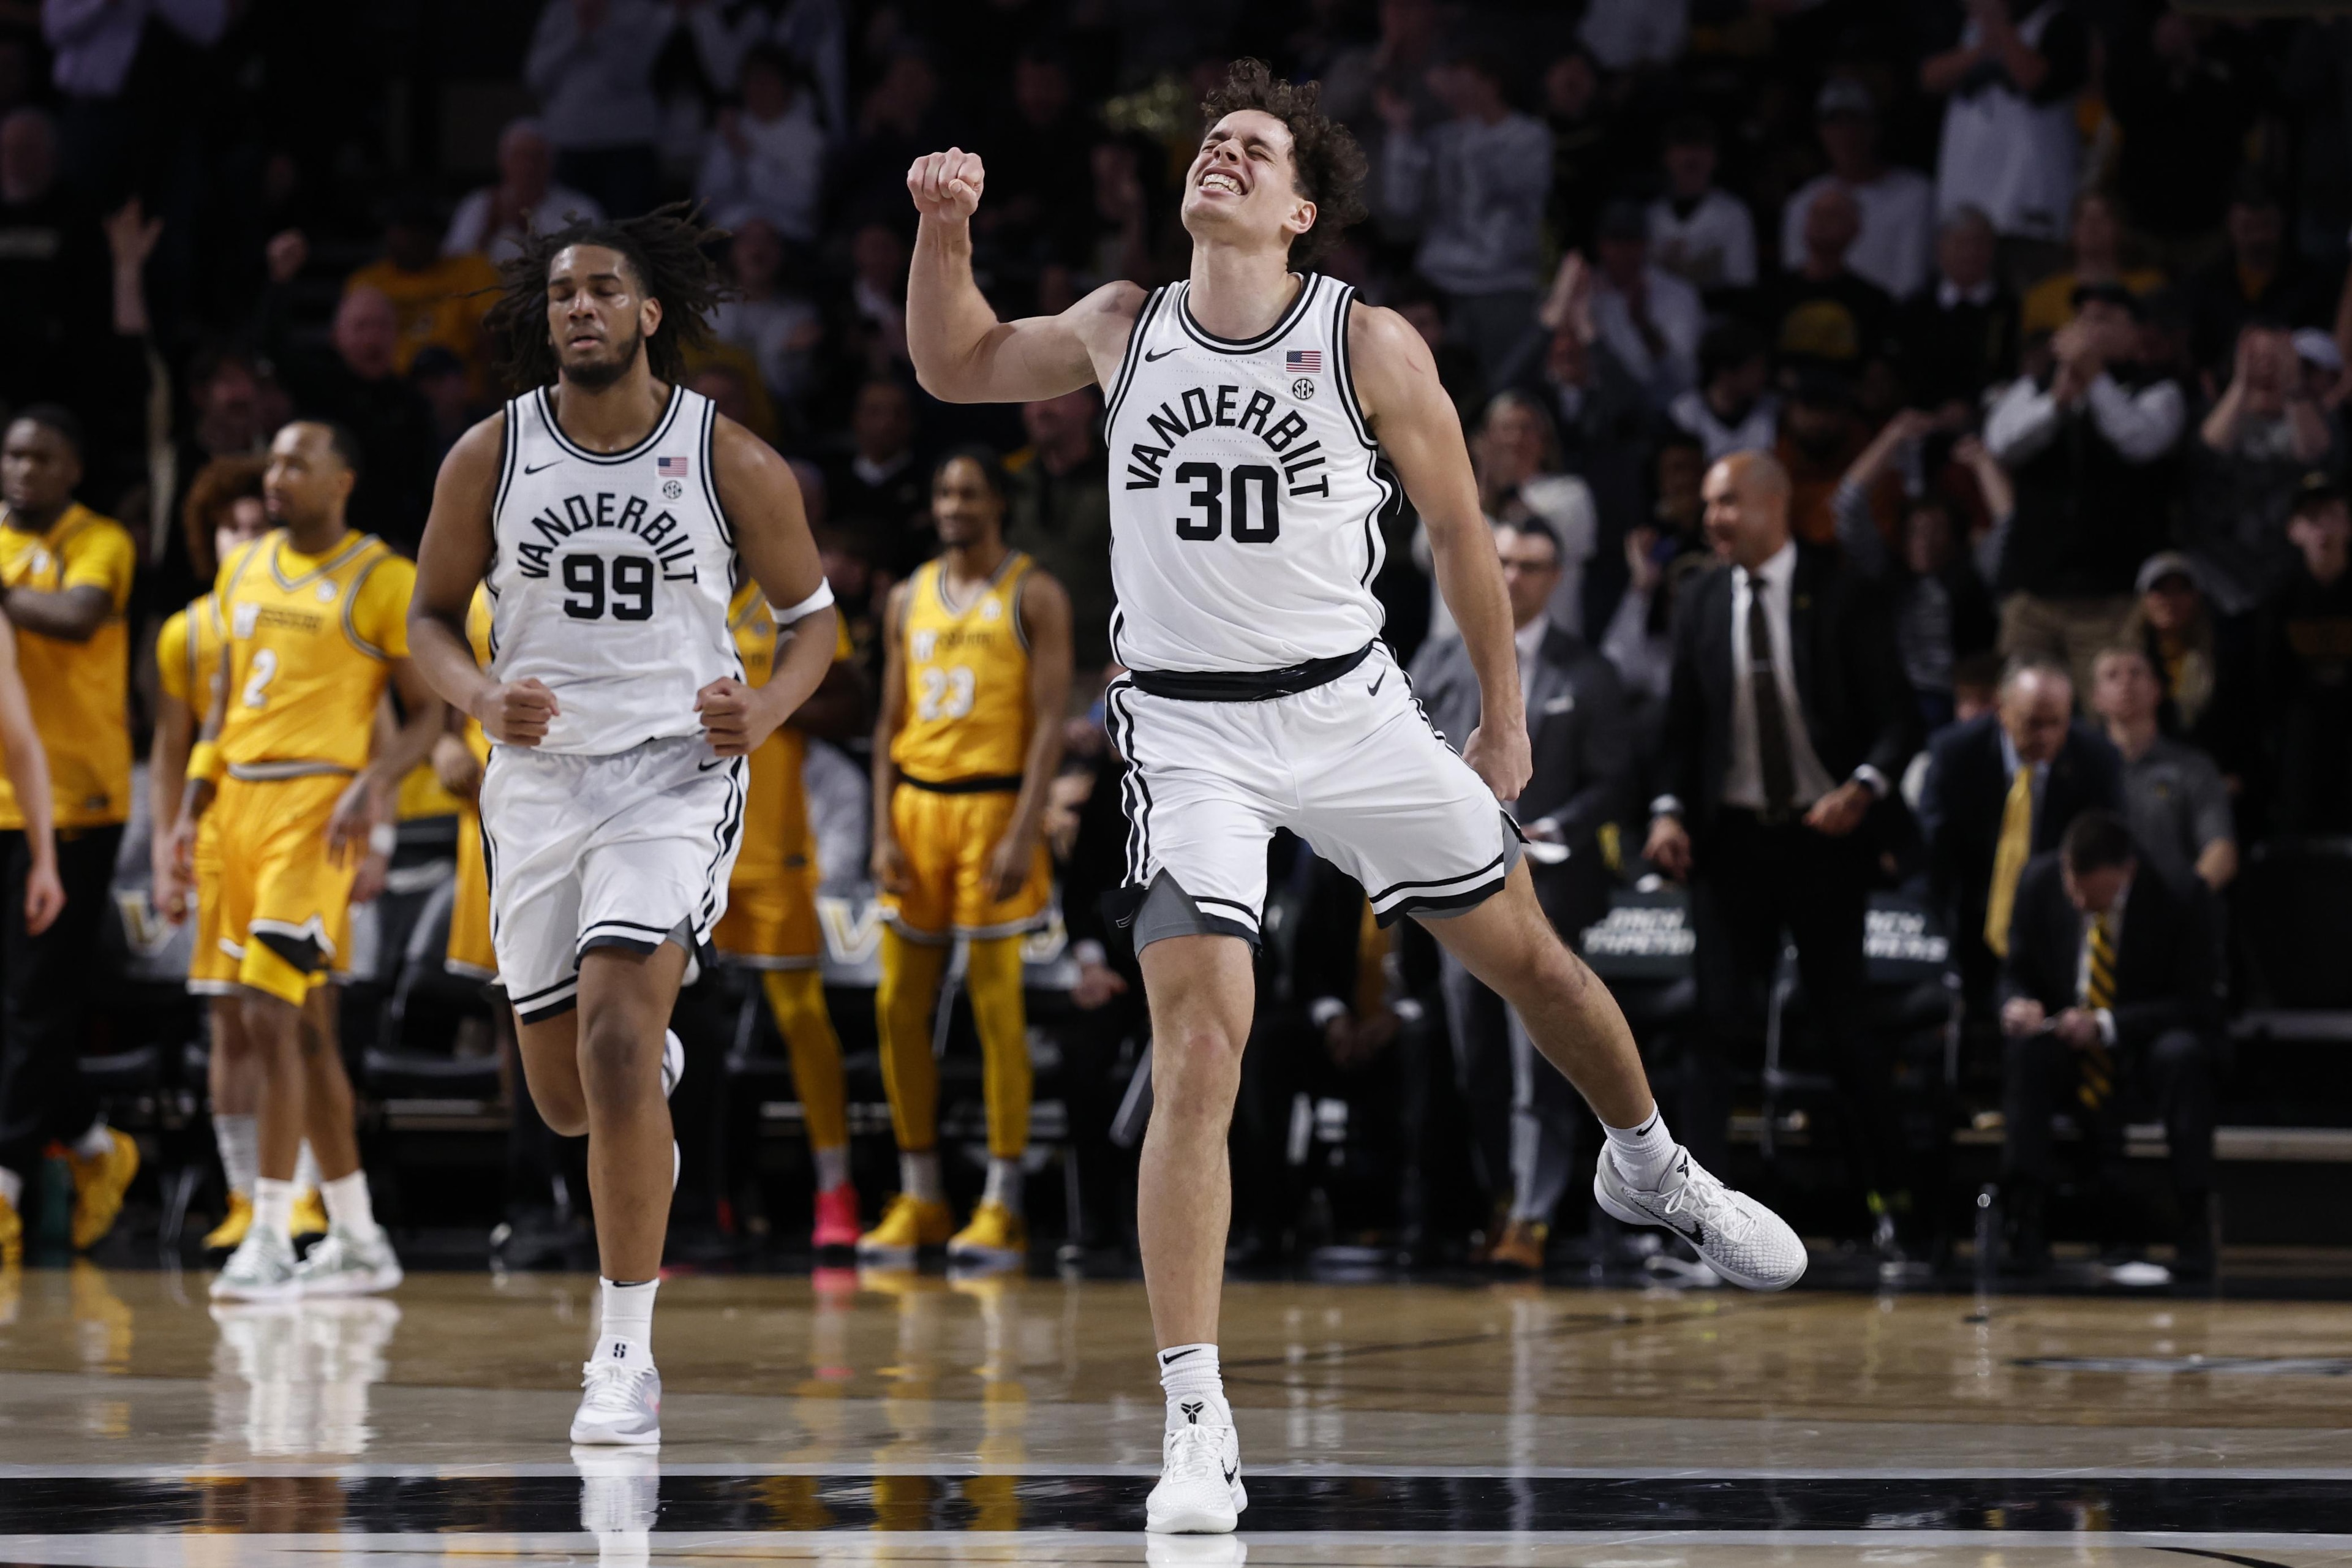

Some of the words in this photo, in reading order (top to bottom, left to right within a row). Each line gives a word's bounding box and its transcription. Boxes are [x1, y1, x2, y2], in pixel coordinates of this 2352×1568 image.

[1292, 379, 1314, 399] SEC
[1126, 385, 1329, 497] VANDERBILT
[1175, 462, 1280, 543] 30
[518, 492, 697, 584] VANDERBILT
[562, 554, 654, 620] 99
[243, 648, 277, 708] 2
[918, 665, 976, 722] 23
